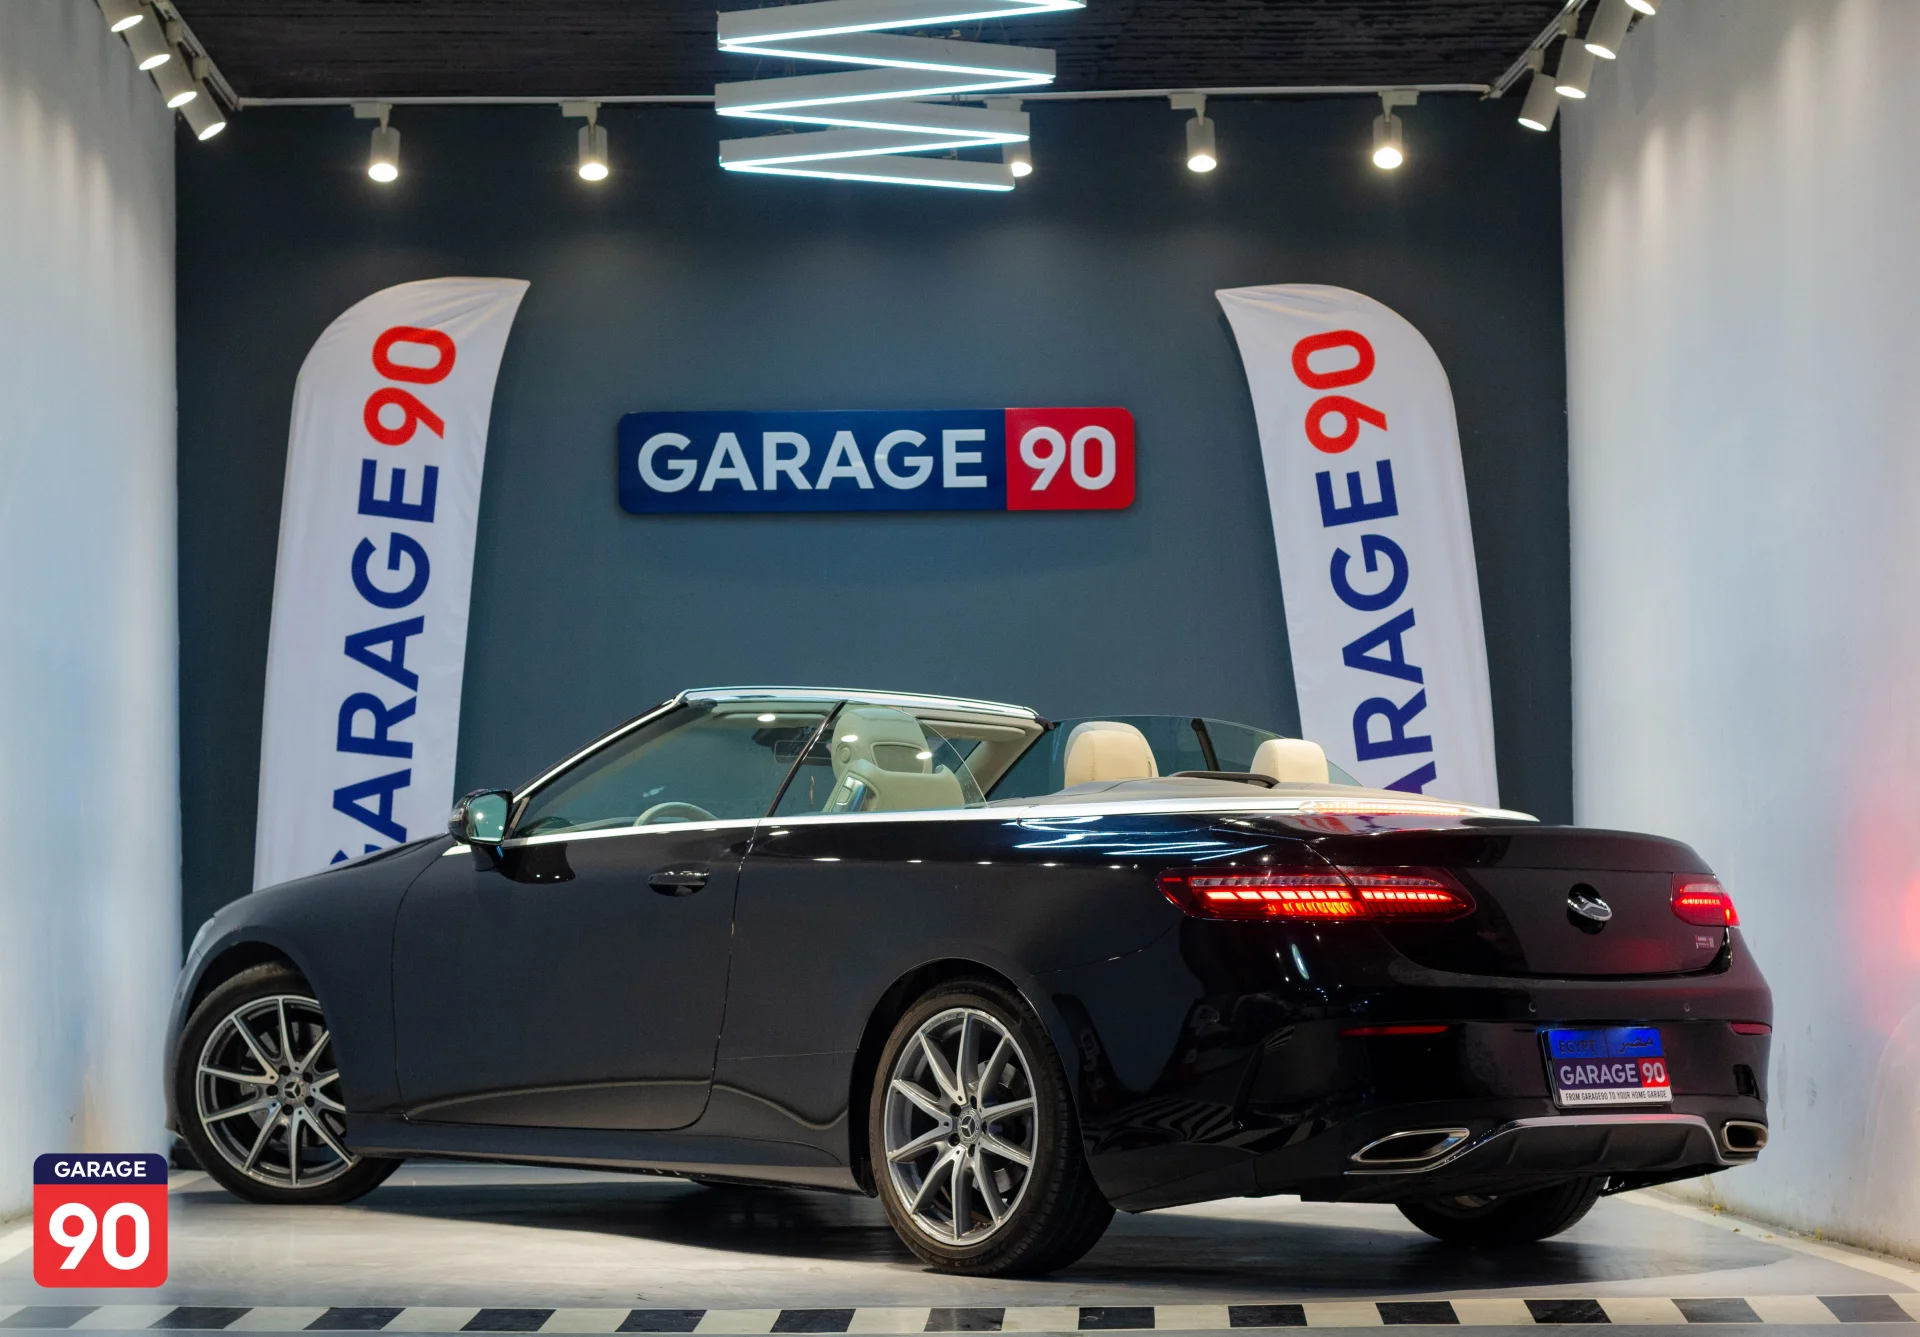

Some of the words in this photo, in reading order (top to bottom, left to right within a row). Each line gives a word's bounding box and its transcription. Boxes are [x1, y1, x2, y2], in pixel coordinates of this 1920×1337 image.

[637, 429, 987, 493] GARAGE
[1019, 425, 1117, 491] 90
[1559, 1040, 1595, 1053] EGYPT
[1618, 1037, 1652, 1054] مصر
[1560, 1063, 1639, 1085] GARAGE
[1642, 1062, 1665, 1083] 90
[1565, 1092, 1580, 1101] FROM
[1617, 1090, 1630, 1099] YOUR
[1631, 1090, 1646, 1099] HOME
[1647, 1090, 1667, 1098] GARAGE
